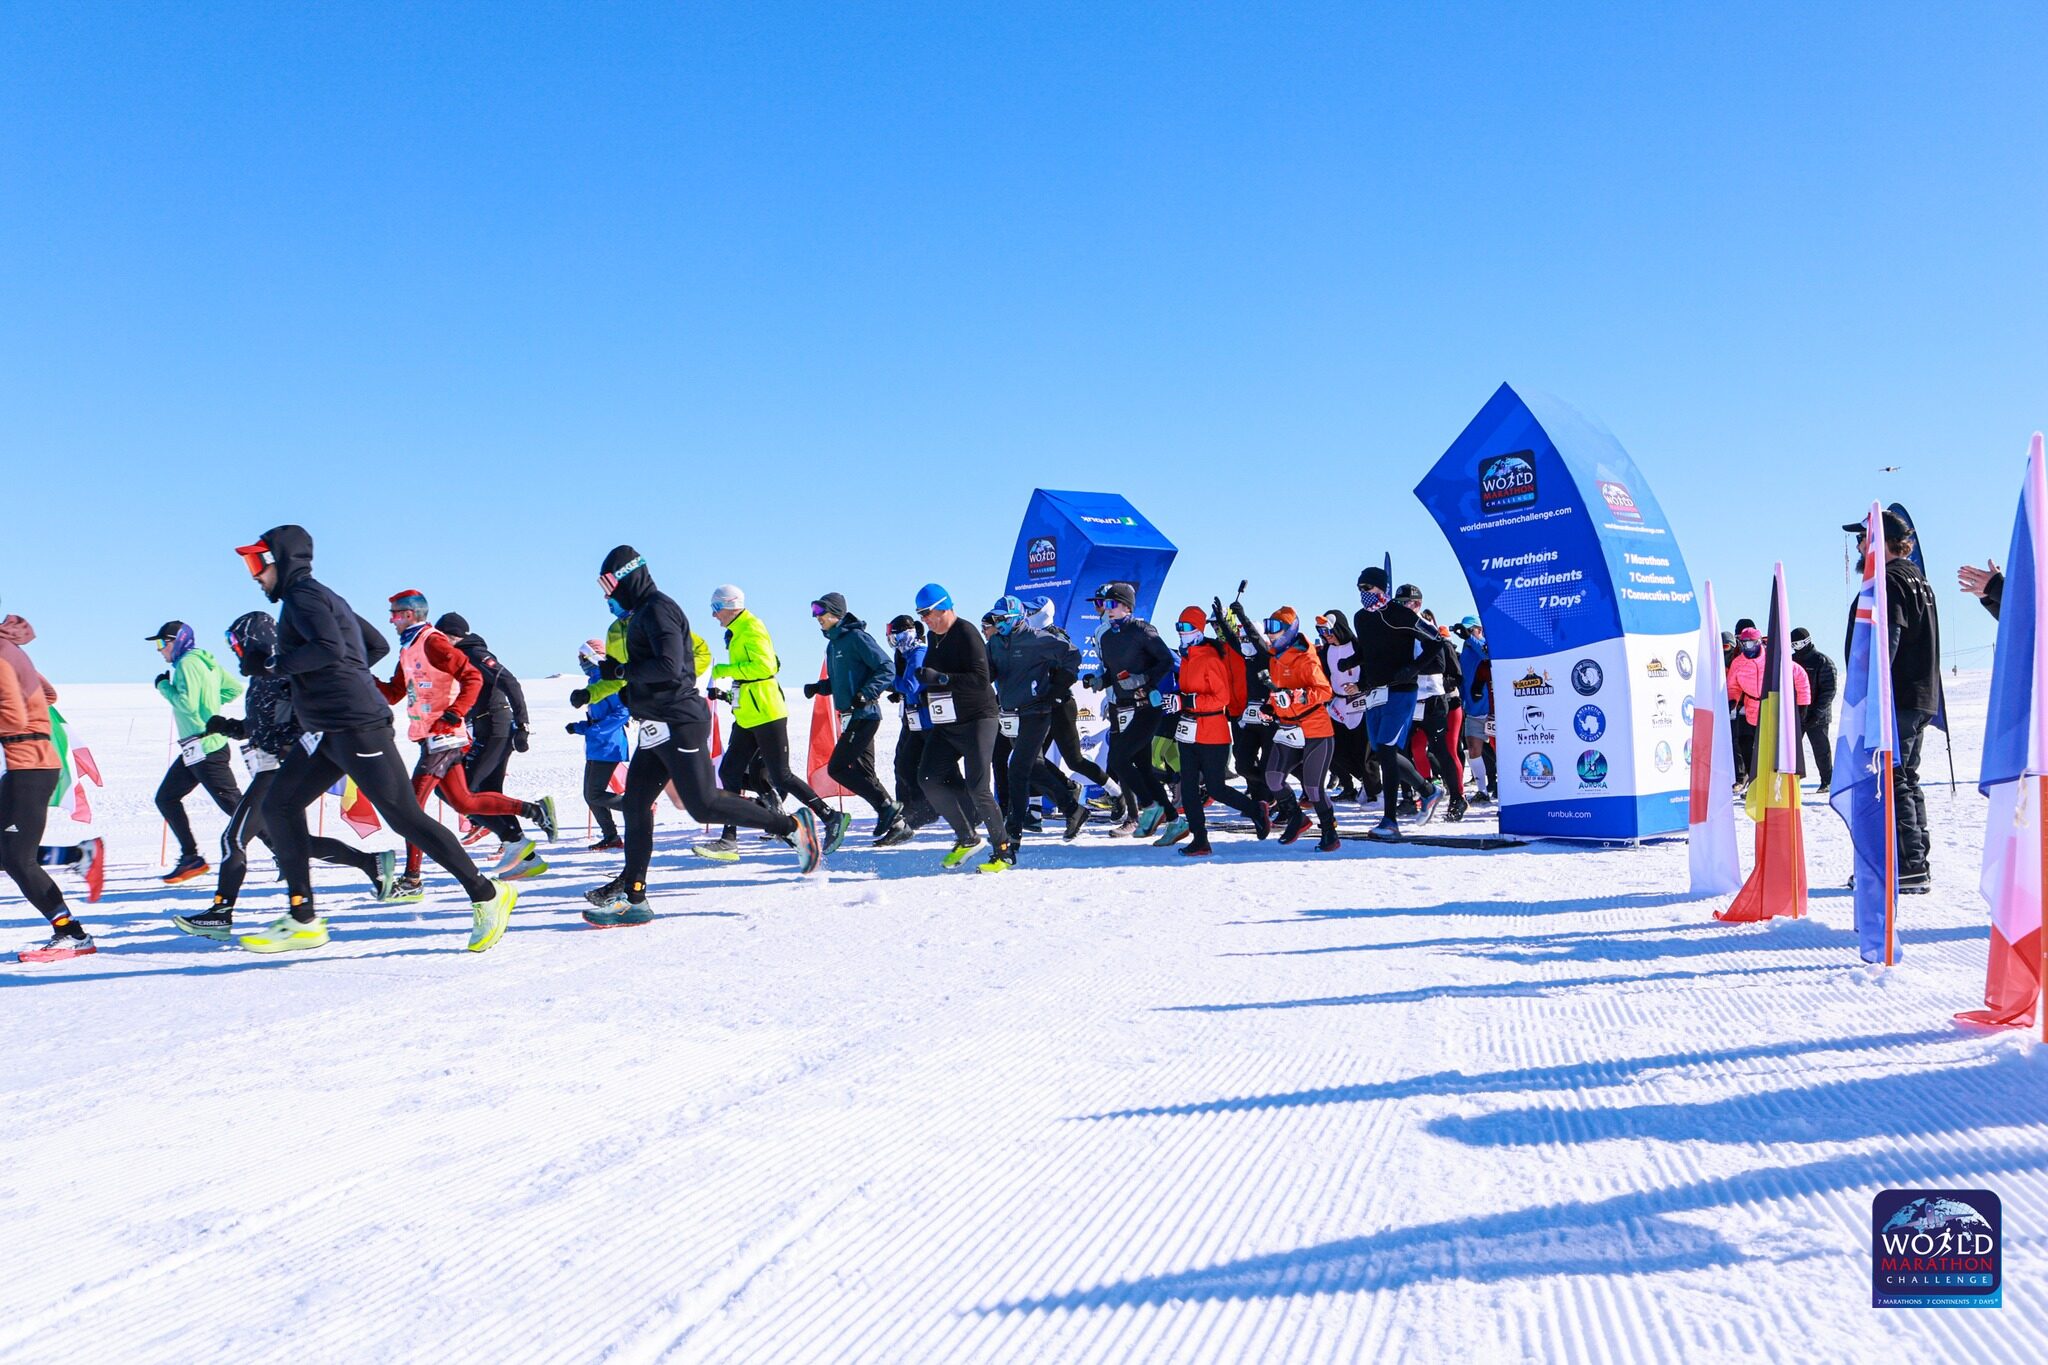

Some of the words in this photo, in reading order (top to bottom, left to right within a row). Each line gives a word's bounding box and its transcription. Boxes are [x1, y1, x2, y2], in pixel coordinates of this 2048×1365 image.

[1483, 472, 1533, 492] WORLD
[1484, 485, 1534, 500] MARATHON
[1460, 507, 1572, 533] worldmarathonchallenge.com
[1482, 559, 1489, 570] 7
[1491, 551, 1558, 569] Marathons
[1624, 553, 1630, 564] 7
[1631, 554, 1670, 567] Marathons
[1504, 578, 1512, 590] 7
[1515, 569, 1583, 588] Continents
[1629, 572, 1635, 582] 7
[1636, 573, 1675, 584] Continents
[1621, 588, 1627, 598] 7
[1627, 588, 1670, 600] Consecutive
[1539, 597, 1547, 608] 7
[1514, 687, 1554, 697] MARATHON
[932, 705, 943, 715] 13
[1540, 732, 1555, 740] Pole
[183, 747, 195, 758] 27
[1548, 810, 1592, 819] runbuk.com
